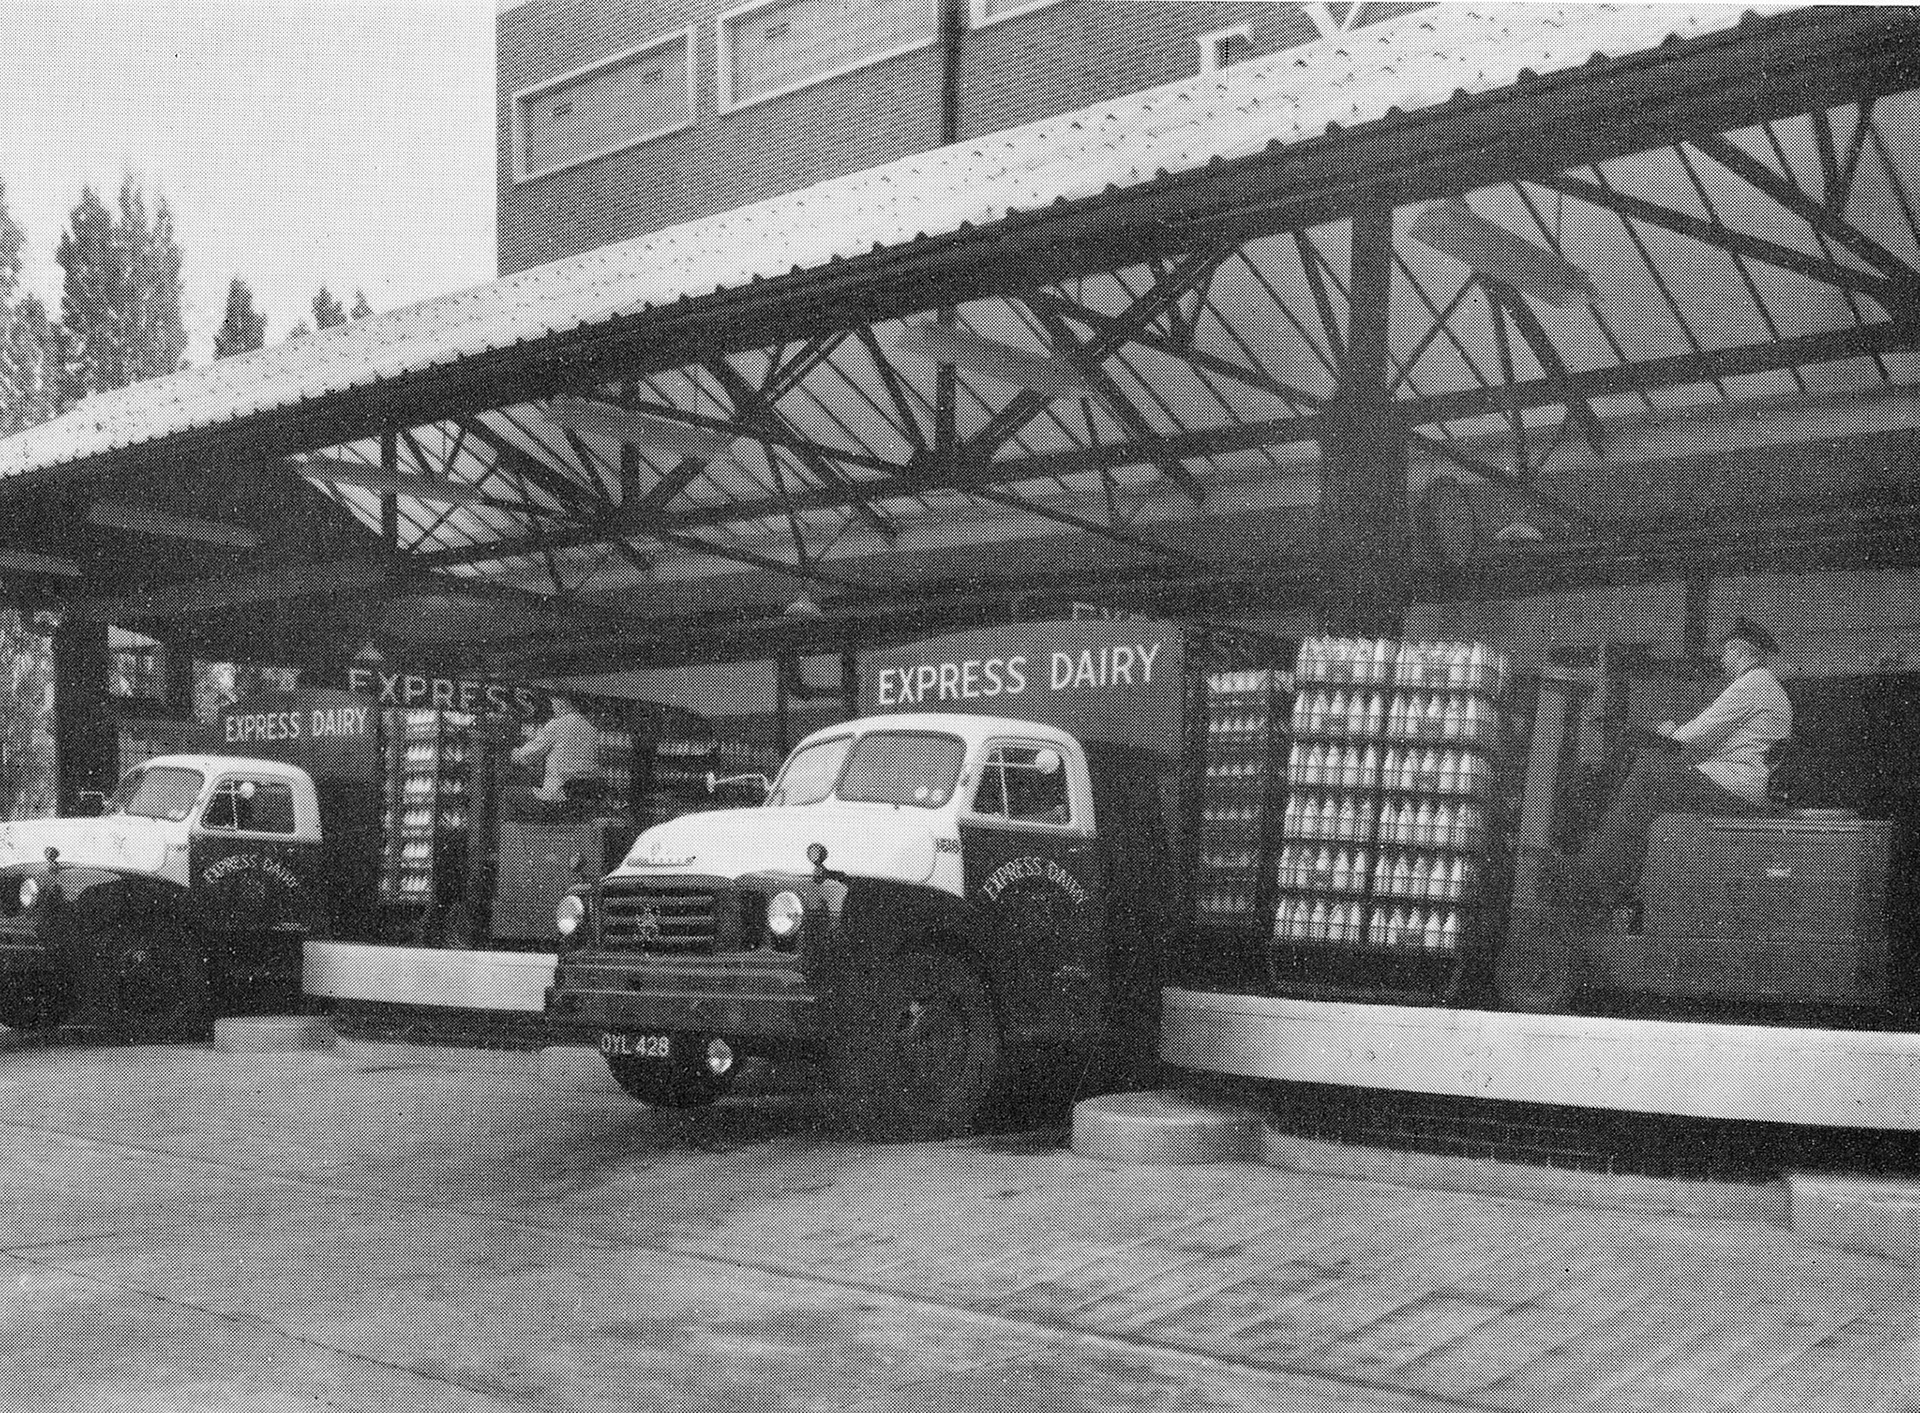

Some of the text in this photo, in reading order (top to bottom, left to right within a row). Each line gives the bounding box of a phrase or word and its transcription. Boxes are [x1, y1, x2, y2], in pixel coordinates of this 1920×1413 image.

[349, 667, 535, 717] EXPRESS
[879, 644, 1160, 704] EXPRESS DAIRY
[226, 703, 367, 743] EXPRESS DAIRY
[202, 854, 258, 884] EXPRESS
[983, 856, 1089, 904] EXPRESS DAIRY
[636, 1035, 669, 1058] 428
